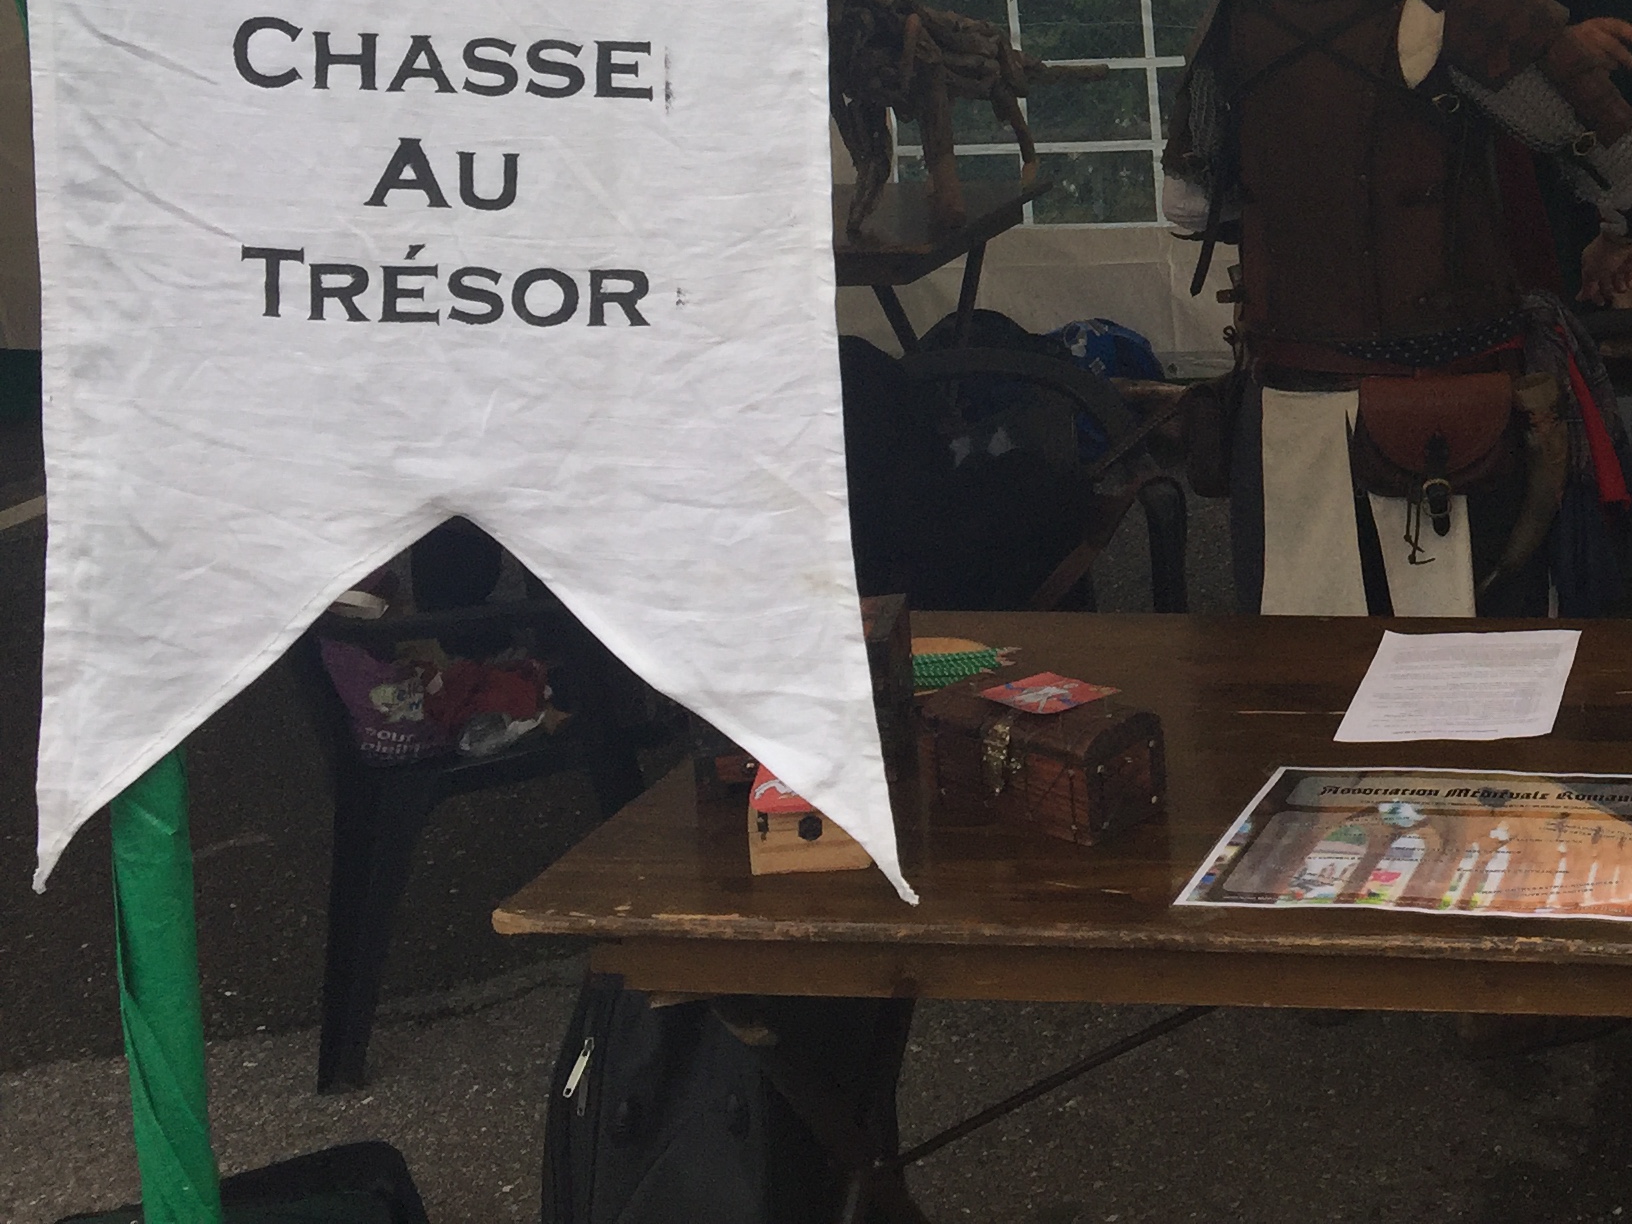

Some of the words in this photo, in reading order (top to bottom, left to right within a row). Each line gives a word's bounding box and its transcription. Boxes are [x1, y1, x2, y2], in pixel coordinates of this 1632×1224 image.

[233, 17, 654, 102] CHASSE
[364, 138, 520, 211] AU
[241, 244, 651, 327] TRÉSOR
